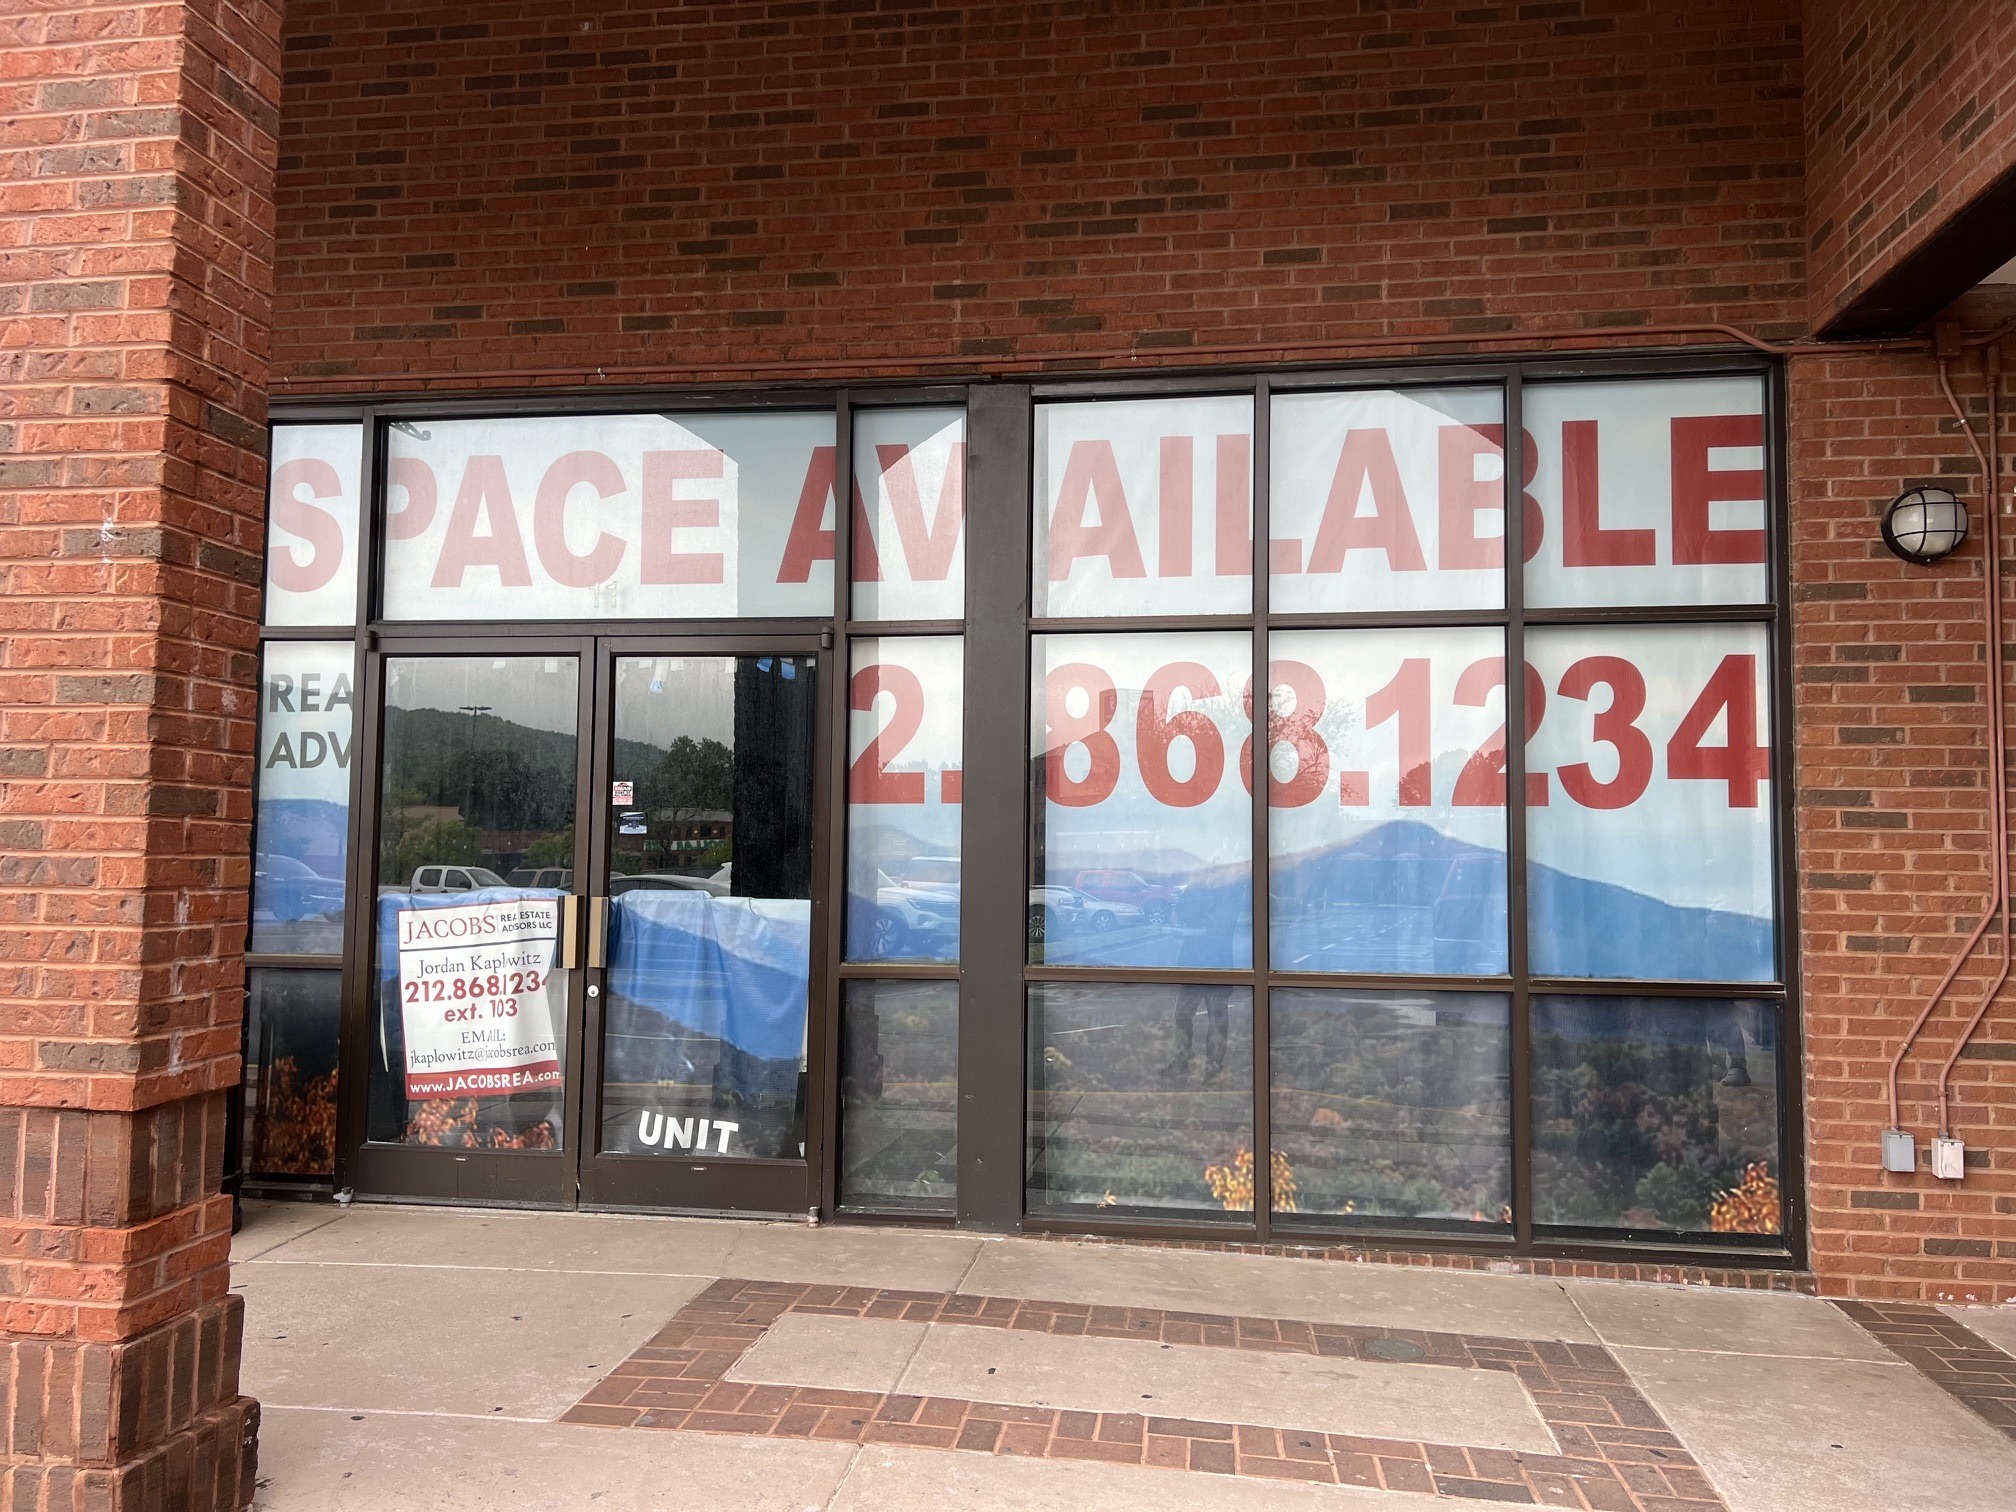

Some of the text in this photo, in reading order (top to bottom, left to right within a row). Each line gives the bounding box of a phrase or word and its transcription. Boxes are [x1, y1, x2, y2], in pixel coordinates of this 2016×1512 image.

[269, 415, 1766, 593] SPACE AVAILABLE
[269, 673, 353, 713] REA
[265, 731, 352, 769] ADV
[403, 915, 496, 945] JACOBS
[520, 911, 551, 920] ESTATE
[538, 921, 553, 929] LLC
[417, 951, 541, 979] Jordan Kaplwitz
[444, 998, 518, 1023] ext. 103
[461, 1029, 506, 1045] EMAIL:
[638, 1110, 739, 1154] UNIT
